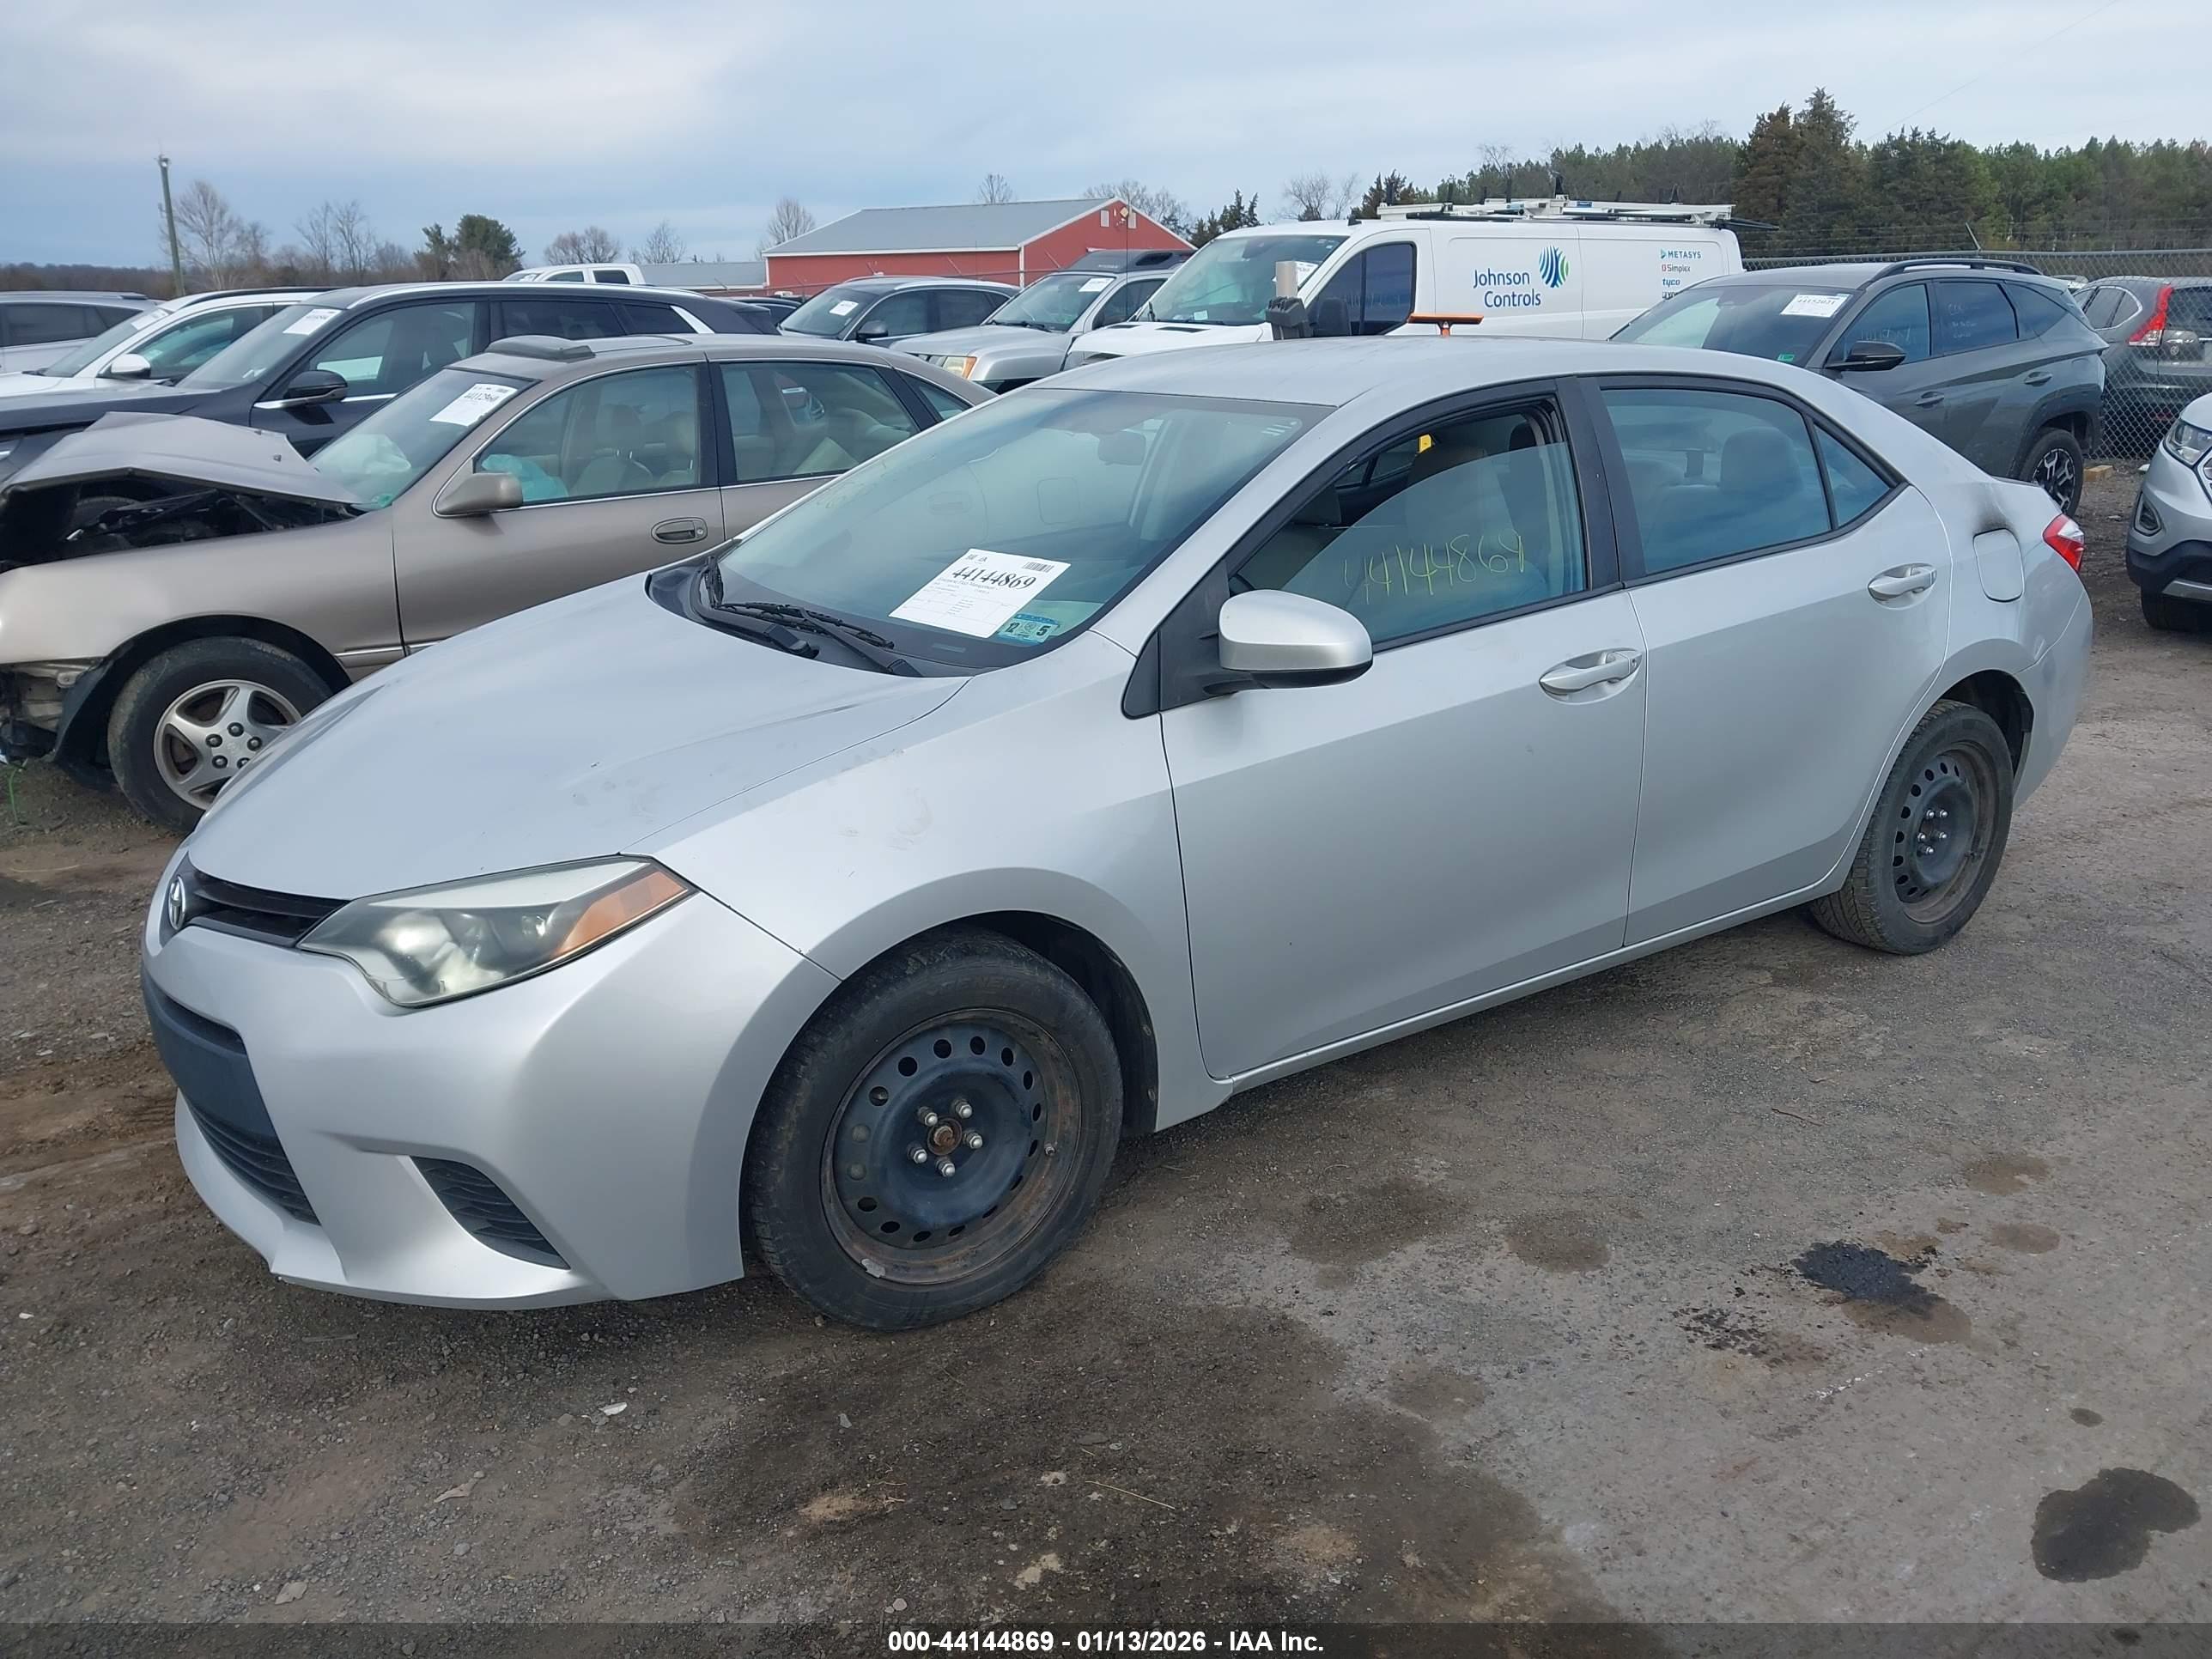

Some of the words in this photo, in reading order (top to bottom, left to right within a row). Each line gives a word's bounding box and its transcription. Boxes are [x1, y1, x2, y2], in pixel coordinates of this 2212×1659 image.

[1668, 250, 1702, 259] METASYS
[1667, 264, 1691, 274] Simplex
[1473, 267, 1530, 289] Johnson
[1662, 277, 1680, 288] tyco
[1484, 288, 1541, 308] Controls
[951, 566, 1036, 590] 44144869
[1005, 622, 1020, 633] 12
[1036, 625, 1051, 636] 5
